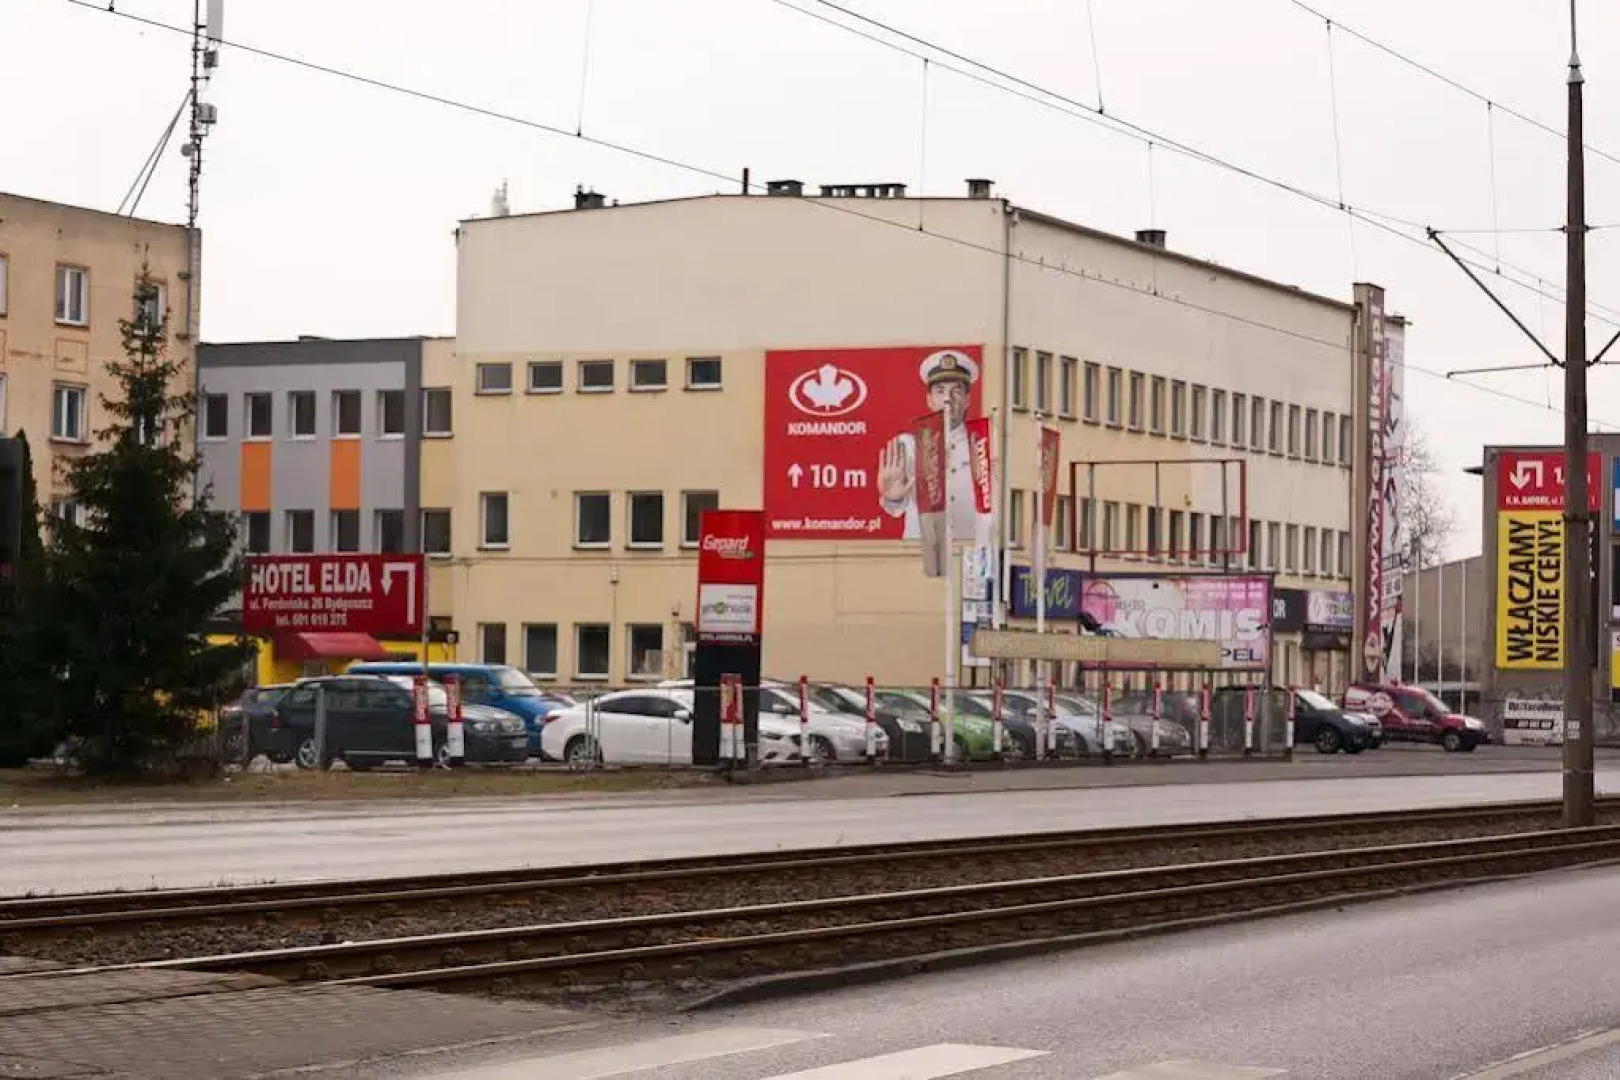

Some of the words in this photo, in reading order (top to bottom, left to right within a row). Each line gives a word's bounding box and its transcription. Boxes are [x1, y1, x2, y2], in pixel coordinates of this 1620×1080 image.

[787, 421, 866, 436] KOMANDOR
[811, 465, 837, 489] 10
[843, 469, 867, 488] m
[771, 517, 882, 532] www.komandor.pl
[1537, 519, 1561, 583] CENY!
[250, 561, 316, 594] HOTEL
[321, 561, 372, 593] ELDA
[1019, 572, 1073, 610] Trvel
[1507, 518, 1536, 662] WŁĄCZAMY
[1114, 607, 1264, 641] KOMIS
[1537, 590, 1561, 662] NISKIE
